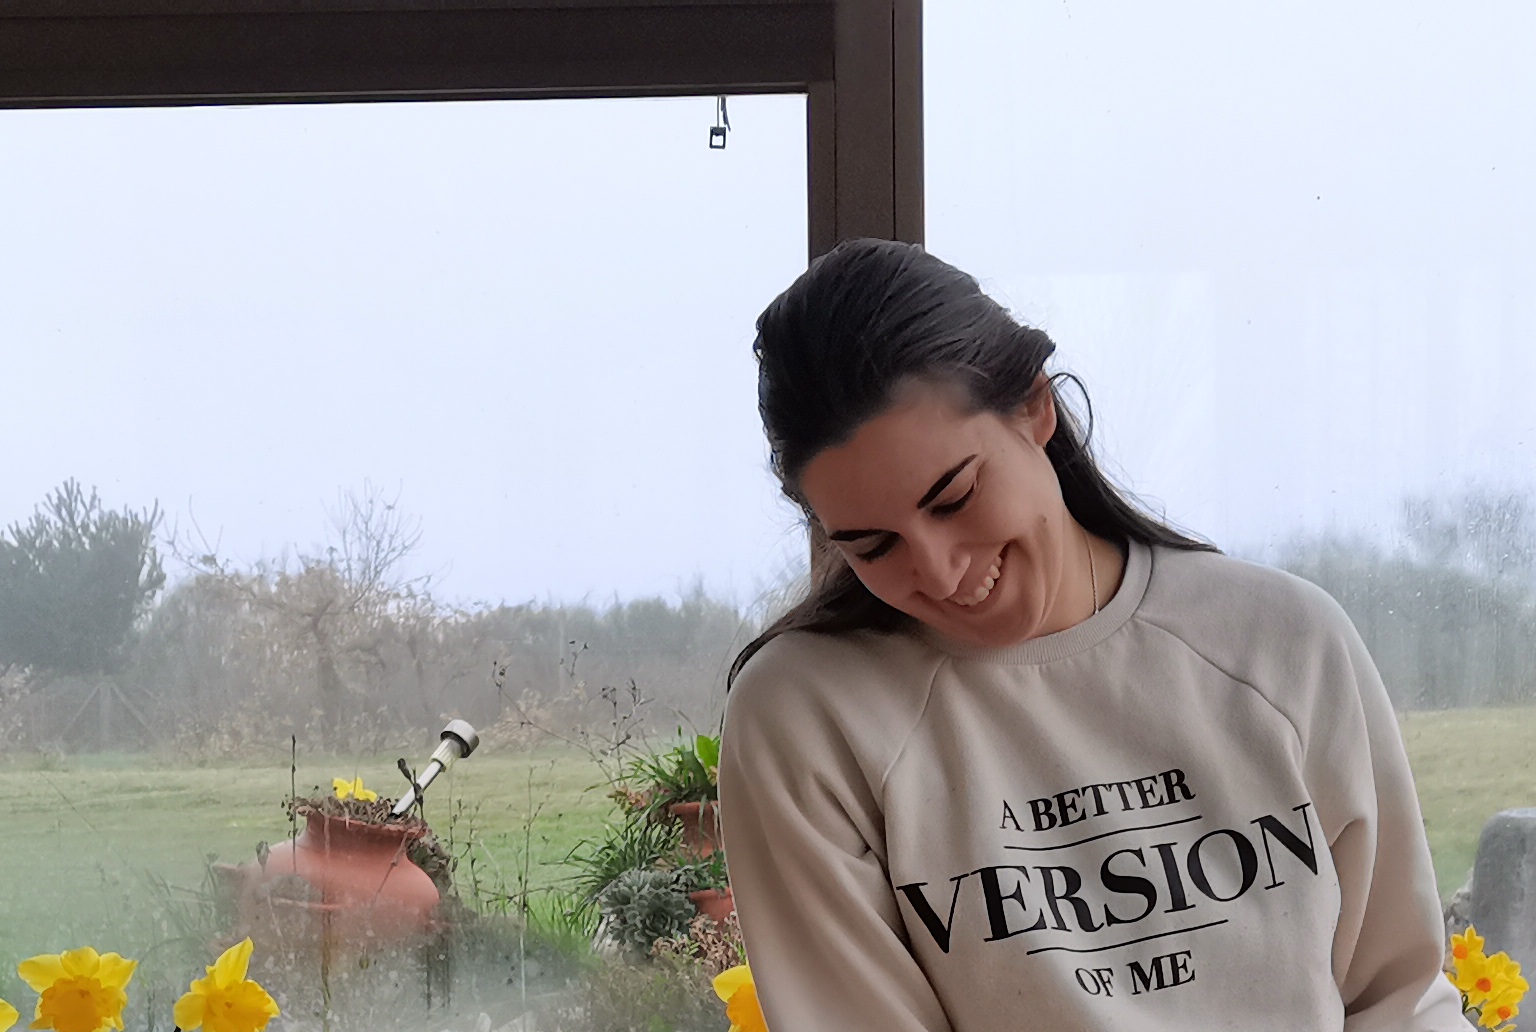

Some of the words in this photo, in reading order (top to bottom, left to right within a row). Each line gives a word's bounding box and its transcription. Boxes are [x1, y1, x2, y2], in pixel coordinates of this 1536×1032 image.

[998, 799, 1025, 832] A
[1026, 768, 1196, 832] BETTER
[896, 802, 1321, 954] VERSION
[1075, 967, 1114, 998] OF
[1126, 950, 1196, 996] ME
